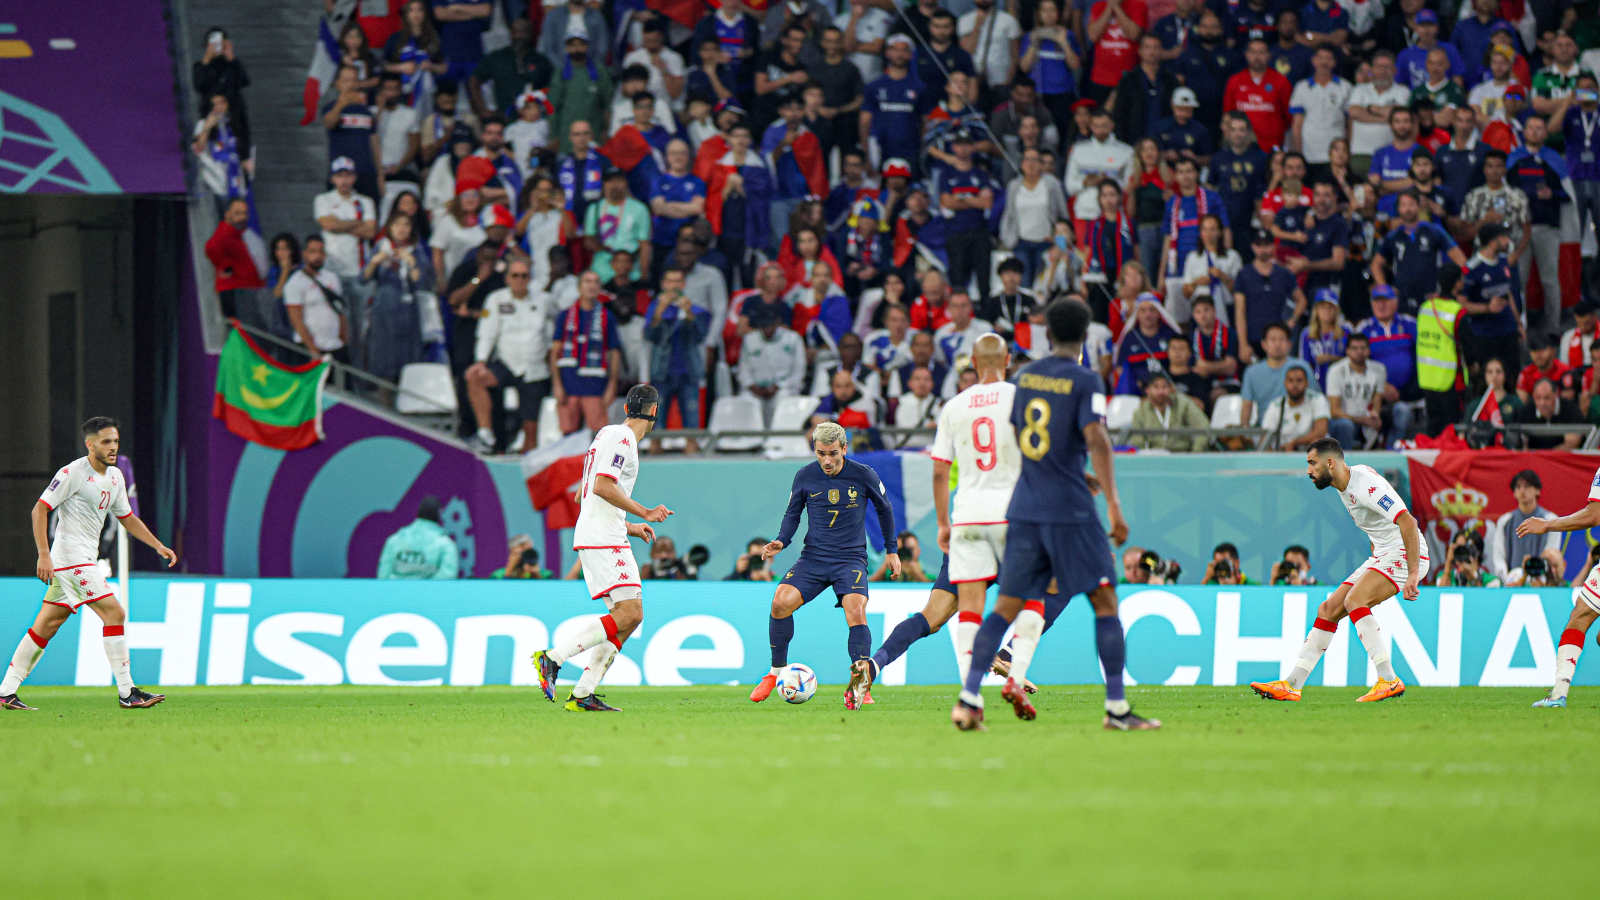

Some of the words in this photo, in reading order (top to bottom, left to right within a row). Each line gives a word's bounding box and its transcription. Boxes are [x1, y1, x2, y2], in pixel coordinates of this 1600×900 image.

[971, 416, 998, 472] 9
[1019, 397, 1051, 462] 8
[827, 510, 840, 528] 7
[851, 569, 863, 584] 7
[75, 582, 745, 686] Hisense
